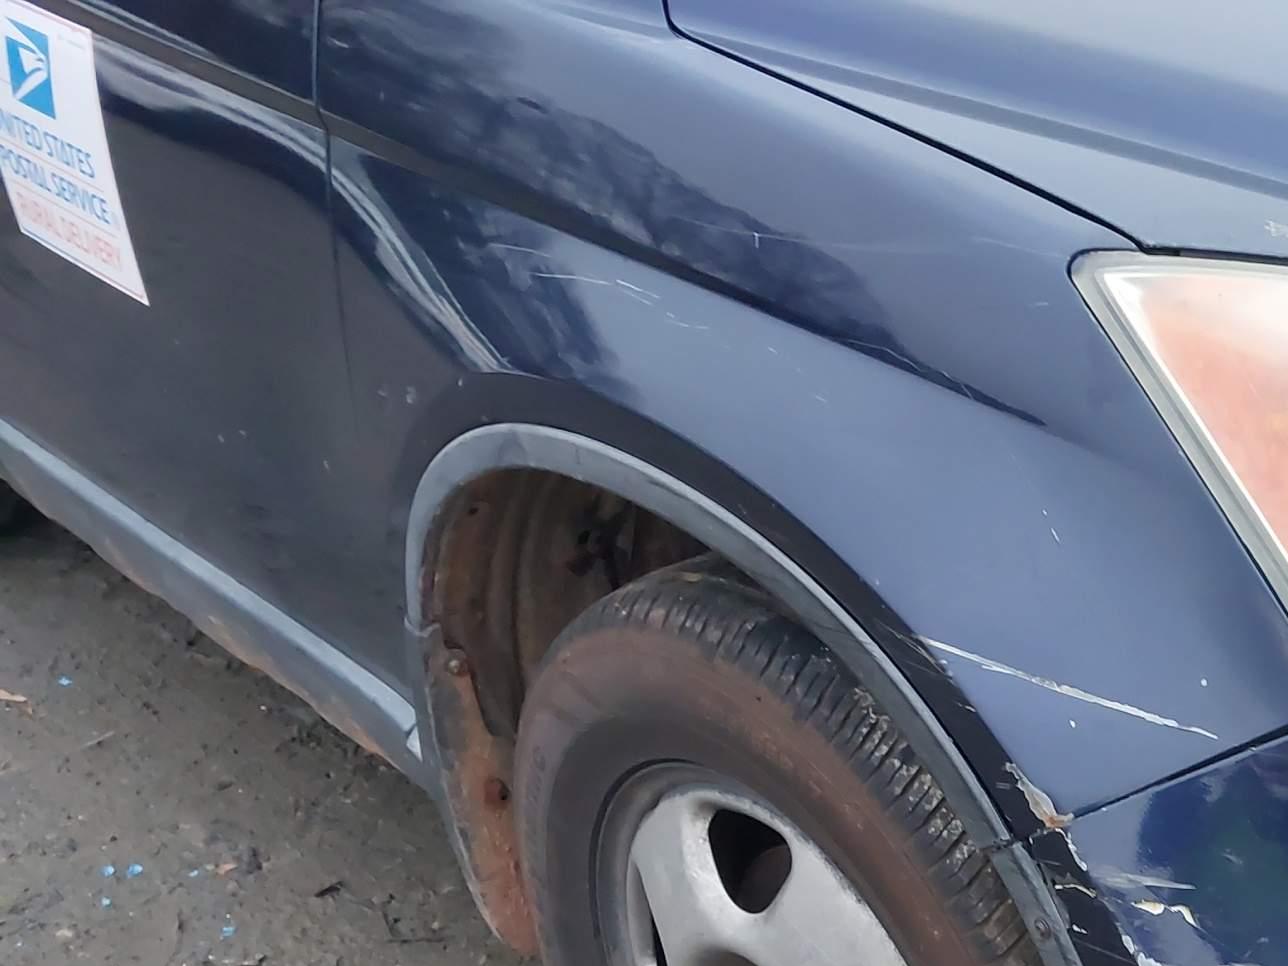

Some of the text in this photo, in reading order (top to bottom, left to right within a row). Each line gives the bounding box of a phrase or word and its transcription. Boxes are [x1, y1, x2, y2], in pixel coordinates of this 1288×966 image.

[0, 108, 96, 179] NITED STATES
[50, 173, 112, 226] SERVICE
